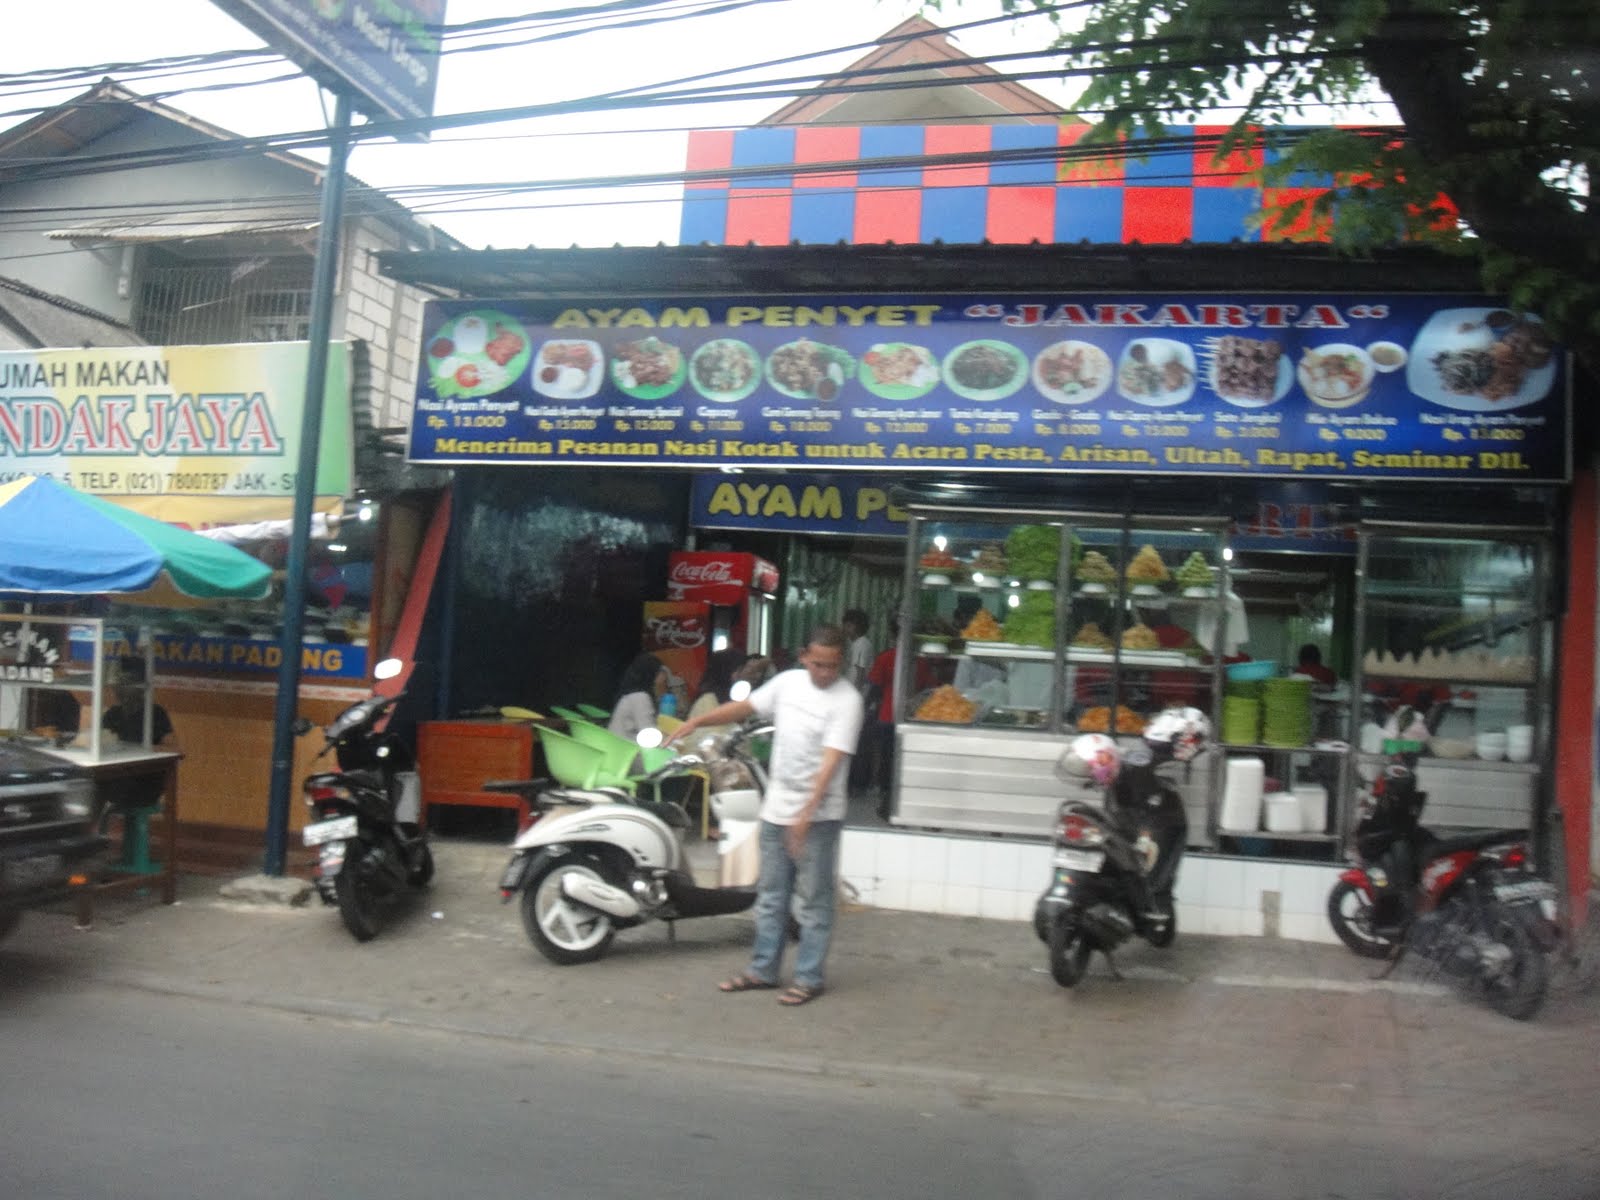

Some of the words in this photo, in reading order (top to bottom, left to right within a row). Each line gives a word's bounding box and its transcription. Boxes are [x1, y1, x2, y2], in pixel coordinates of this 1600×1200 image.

[552, 307, 711, 328] AYAM
[727, 305, 942, 327] PENYET
[76, 361, 170, 386] MAKAN
[0, 394, 140, 457] NDAK
[140, 392, 285, 457] JAYA
[435, 437, 552, 453] Menerima
[558, 439, 659, 455] Pesanan
[664, 440, 717, 455] Nasi
[722, 441, 798, 456] Kotak
[805, 442, 886, 458] untuk
[892, 443, 968, 459] Acara
[974, 444, 1053, 463] Pesta,
[1060, 445, 1157, 465] Arisan,
[1257, 449, 1346, 470] Rapat,
[1353, 450, 1473, 468] Seminar
[80, 472, 121, 489] TELP.
[126, 472, 163, 491] (021)
[234, 472, 266, 490] JAK
[708, 482, 842, 519] AYAM
[231, 643, 343, 671] PADNG
